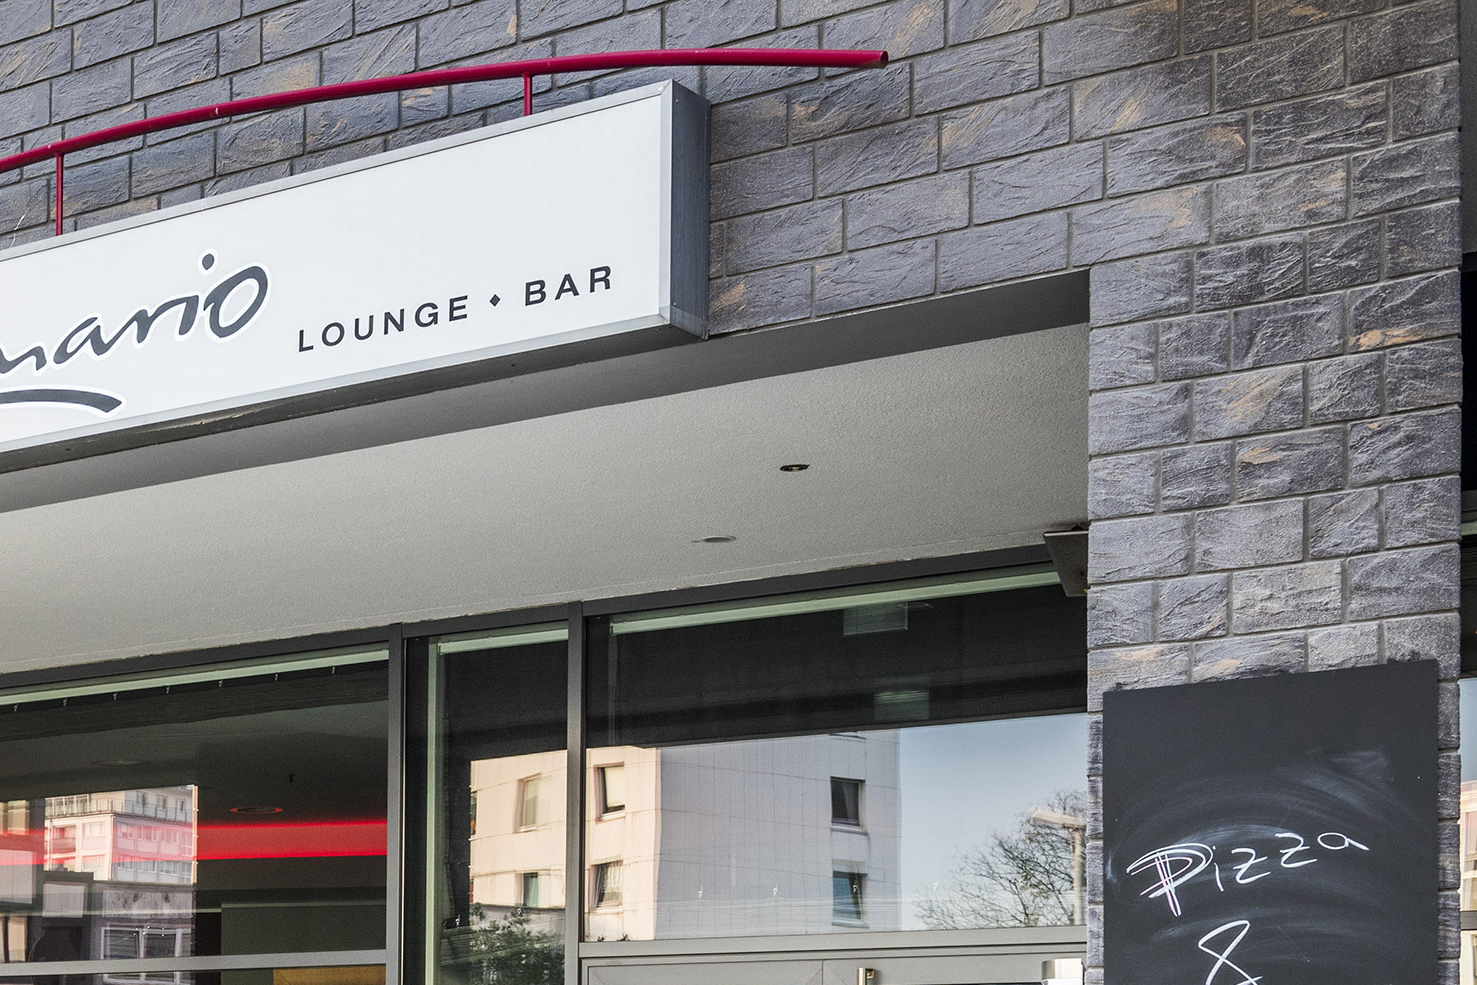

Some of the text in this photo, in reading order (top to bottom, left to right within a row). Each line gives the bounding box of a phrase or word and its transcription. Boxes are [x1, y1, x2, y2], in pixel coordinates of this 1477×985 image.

[299, 265, 612, 353] LOUNGE BAR
[1126, 830, 1370, 918] Pizza
